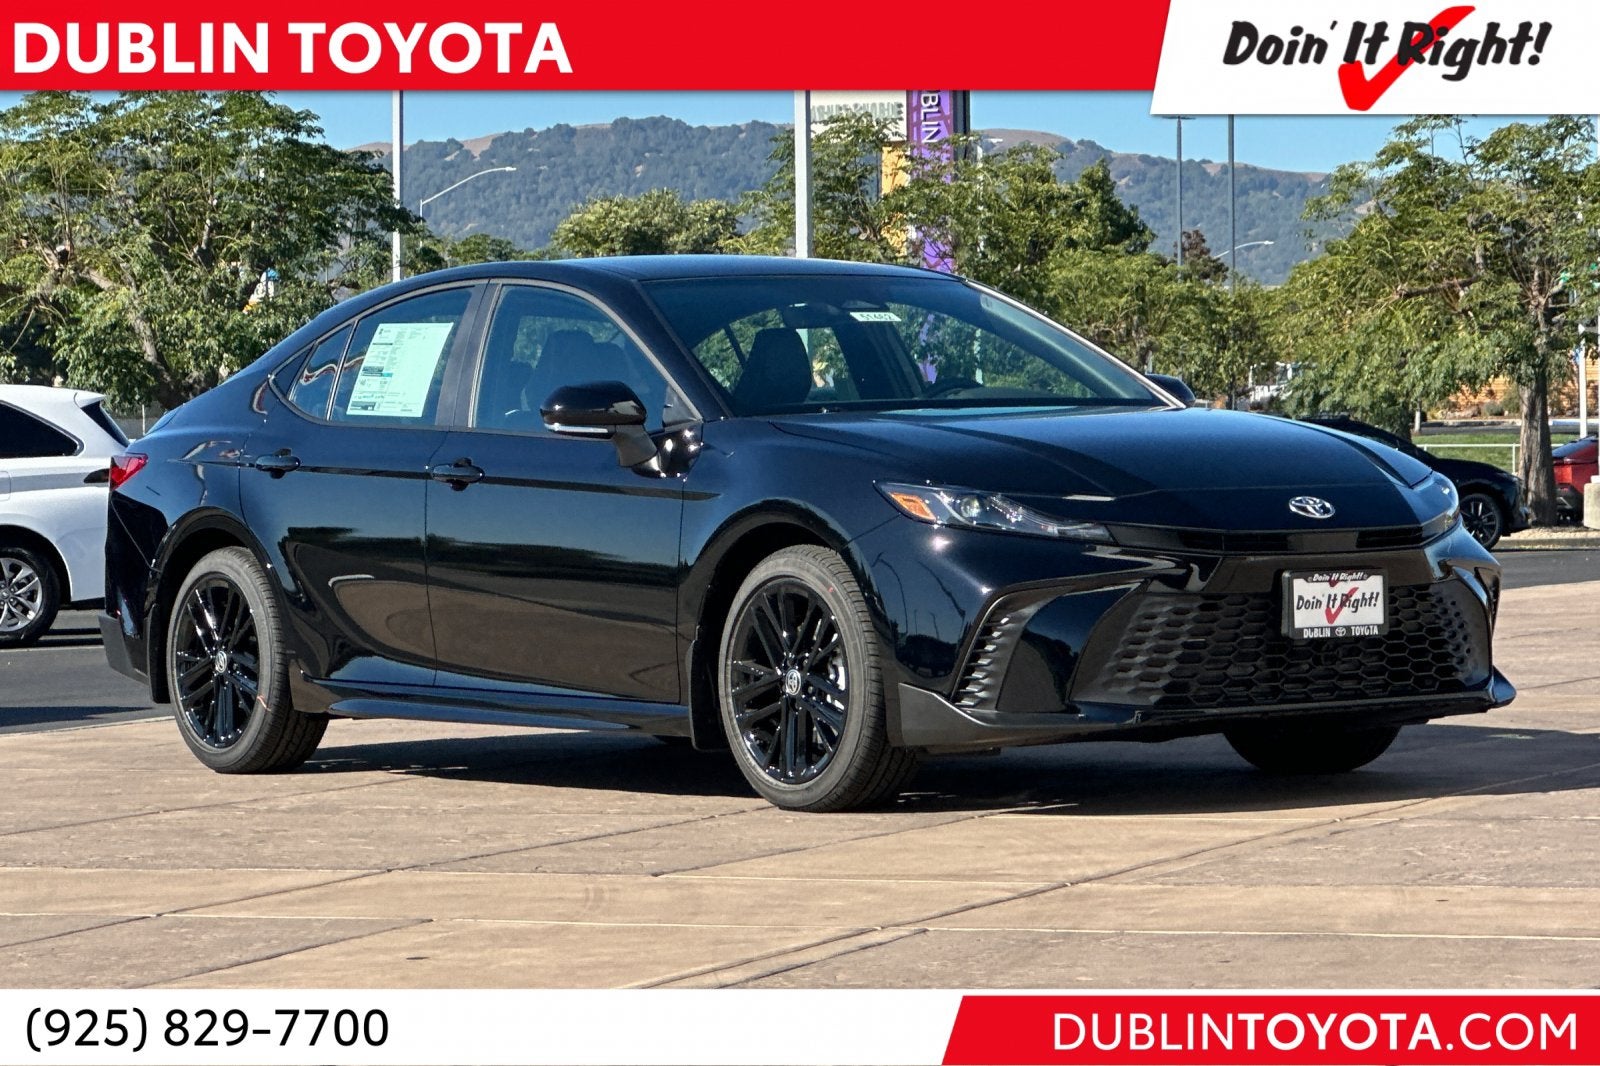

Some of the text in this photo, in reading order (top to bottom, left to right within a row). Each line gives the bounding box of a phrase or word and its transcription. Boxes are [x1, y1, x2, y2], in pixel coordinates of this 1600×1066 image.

[920, 91, 939, 143] BLIN
[1327, 593, 1338, 609] It
[1340, 592, 1380, 613] Right!
[1303, 625, 1379, 638] DUBLIN TOYOTA
